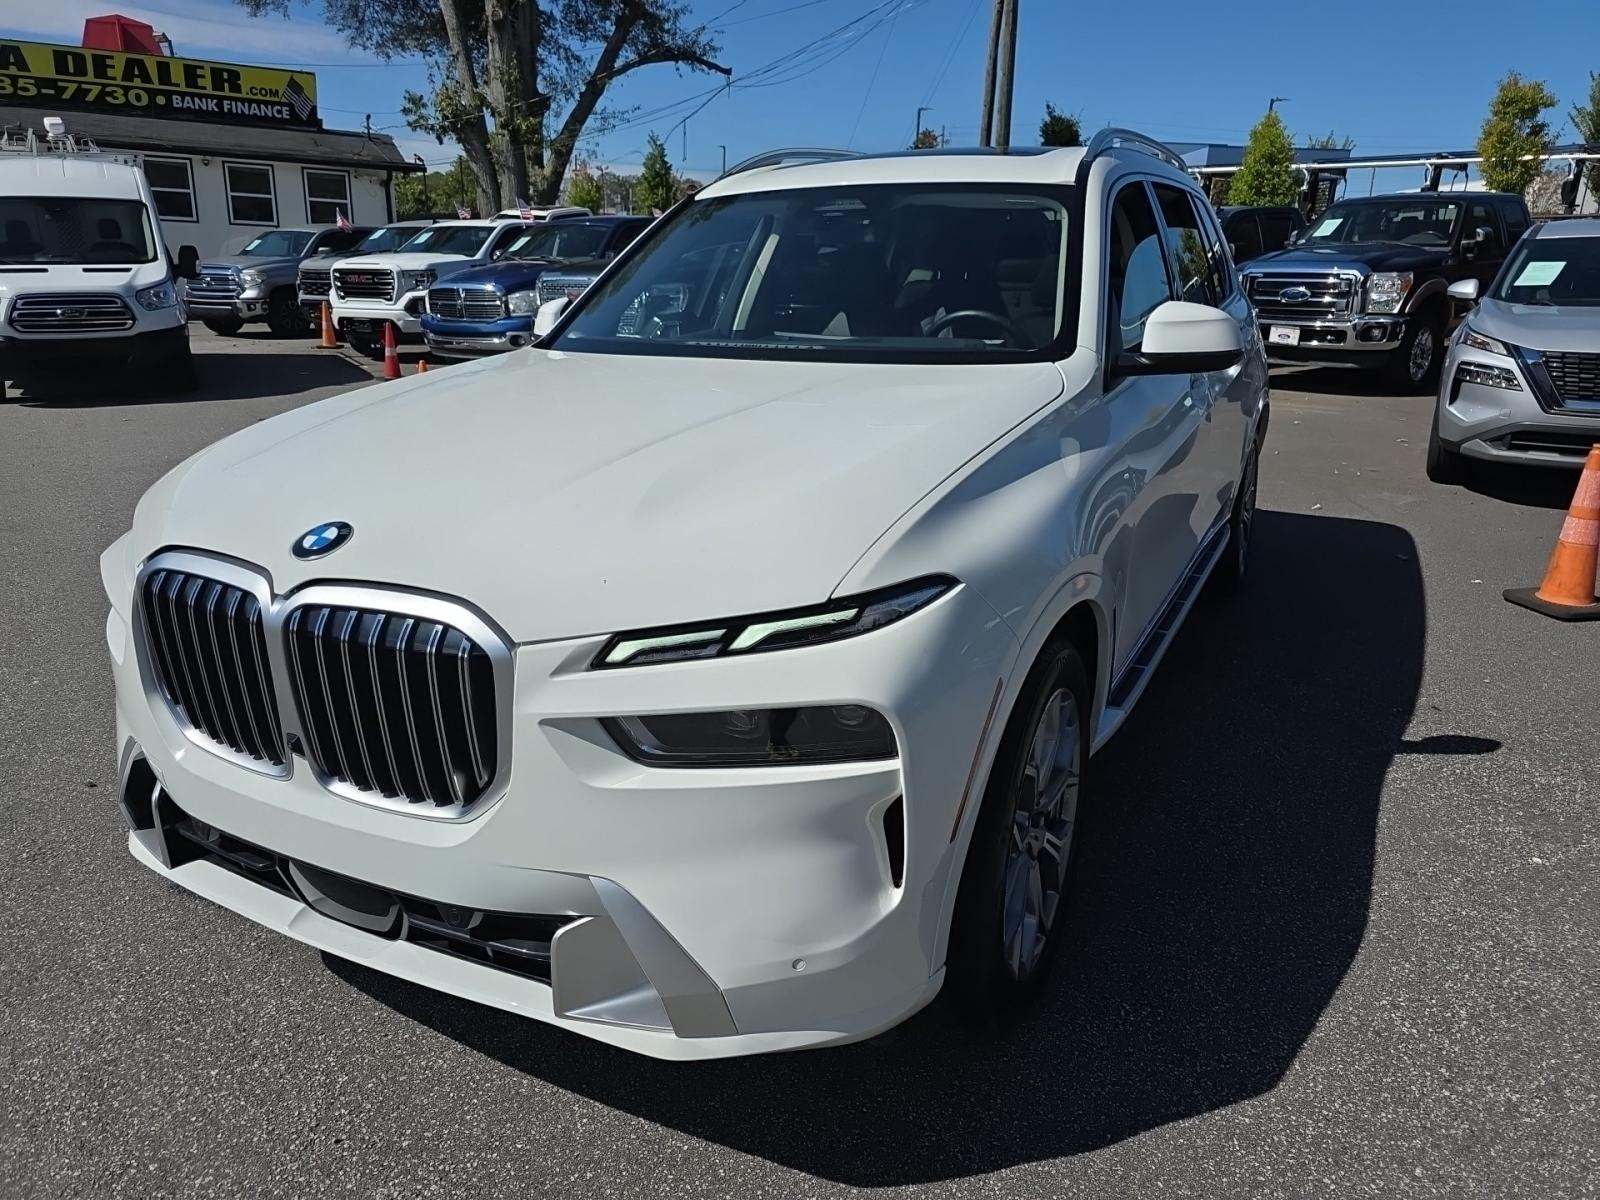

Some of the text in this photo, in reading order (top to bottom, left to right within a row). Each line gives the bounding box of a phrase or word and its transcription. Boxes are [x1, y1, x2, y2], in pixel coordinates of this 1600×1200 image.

[0, 45, 32, 72] A
[172, 95, 220, 112] BANK
[223, 100, 290, 119] FINANCE
